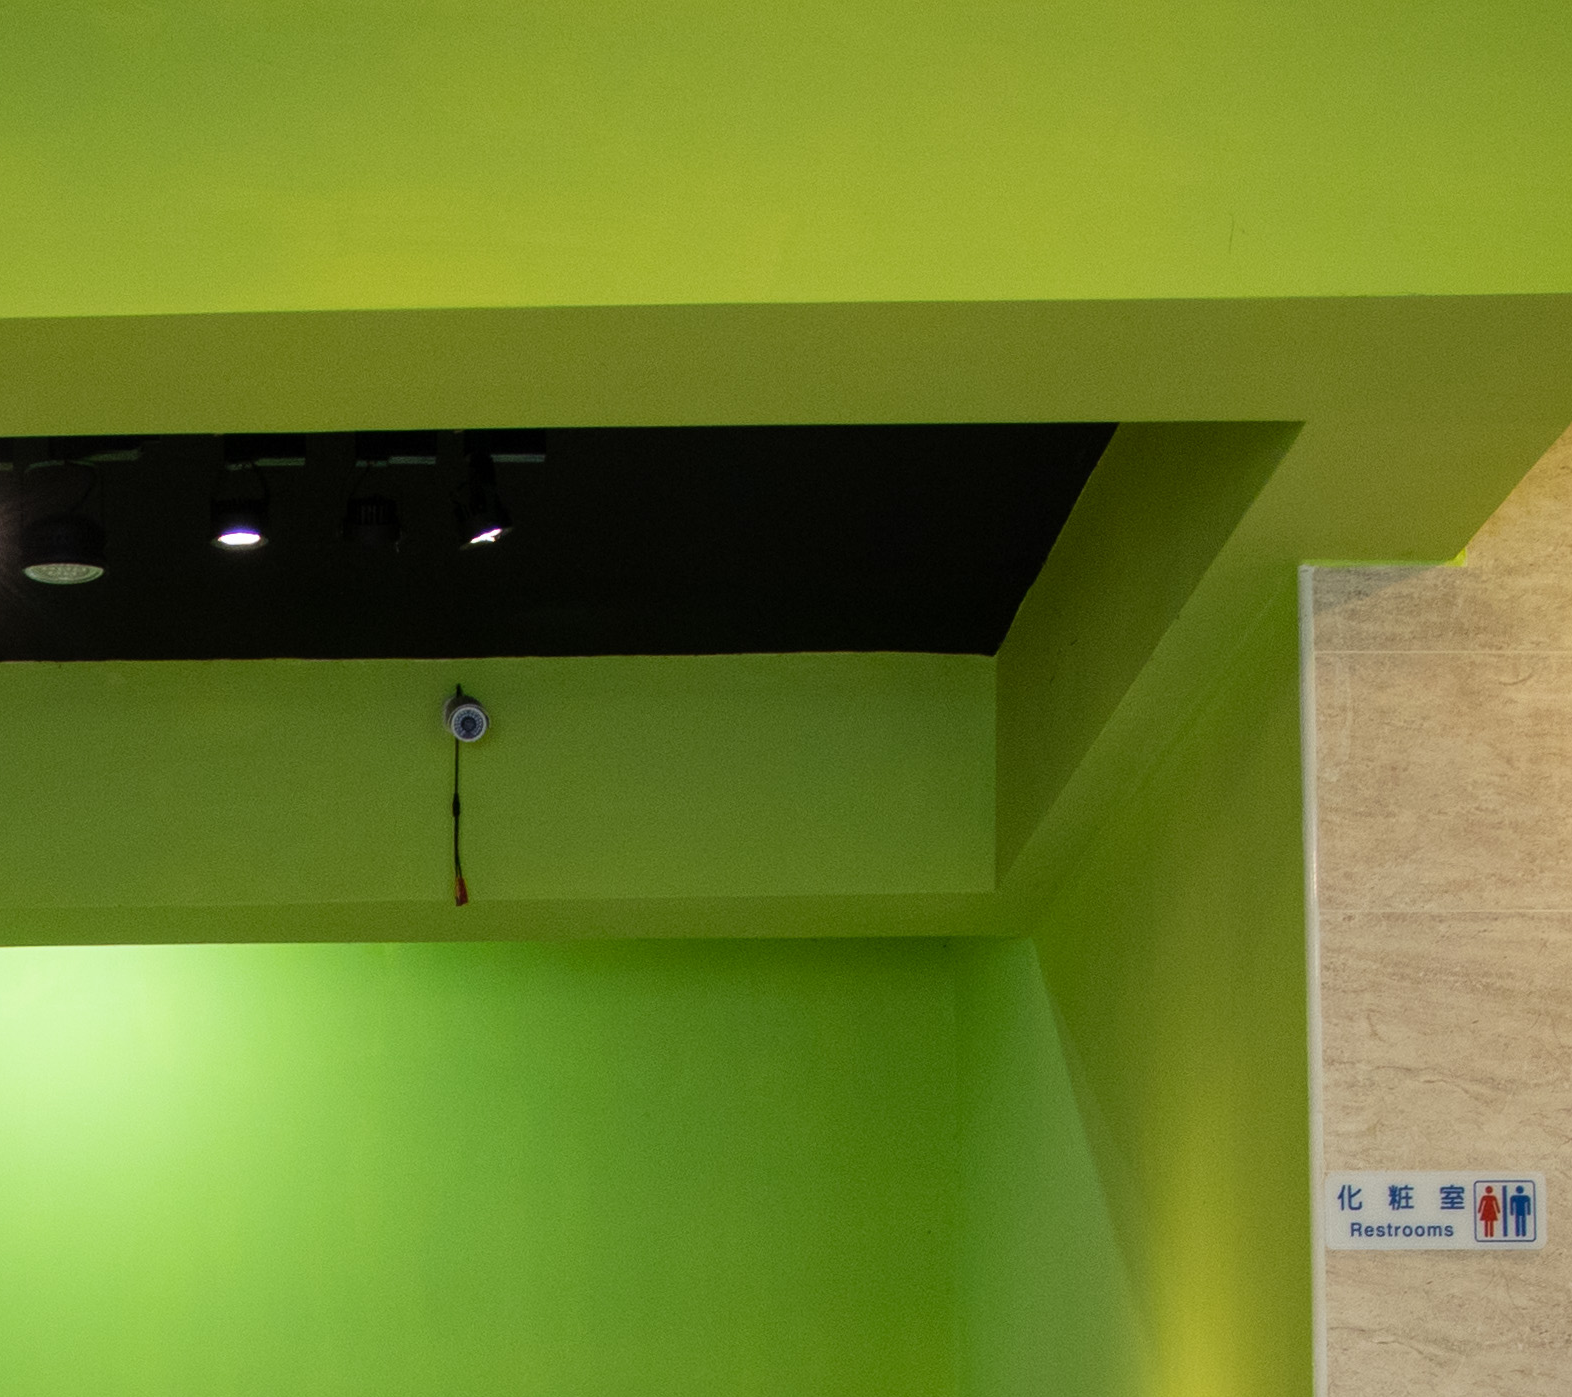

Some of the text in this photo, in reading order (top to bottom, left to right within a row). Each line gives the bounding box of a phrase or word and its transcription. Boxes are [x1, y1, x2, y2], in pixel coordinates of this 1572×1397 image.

[1337, 1184, 1466, 1211] 化粧室
[1349, 1222, 1454, 1238] Restrooms
